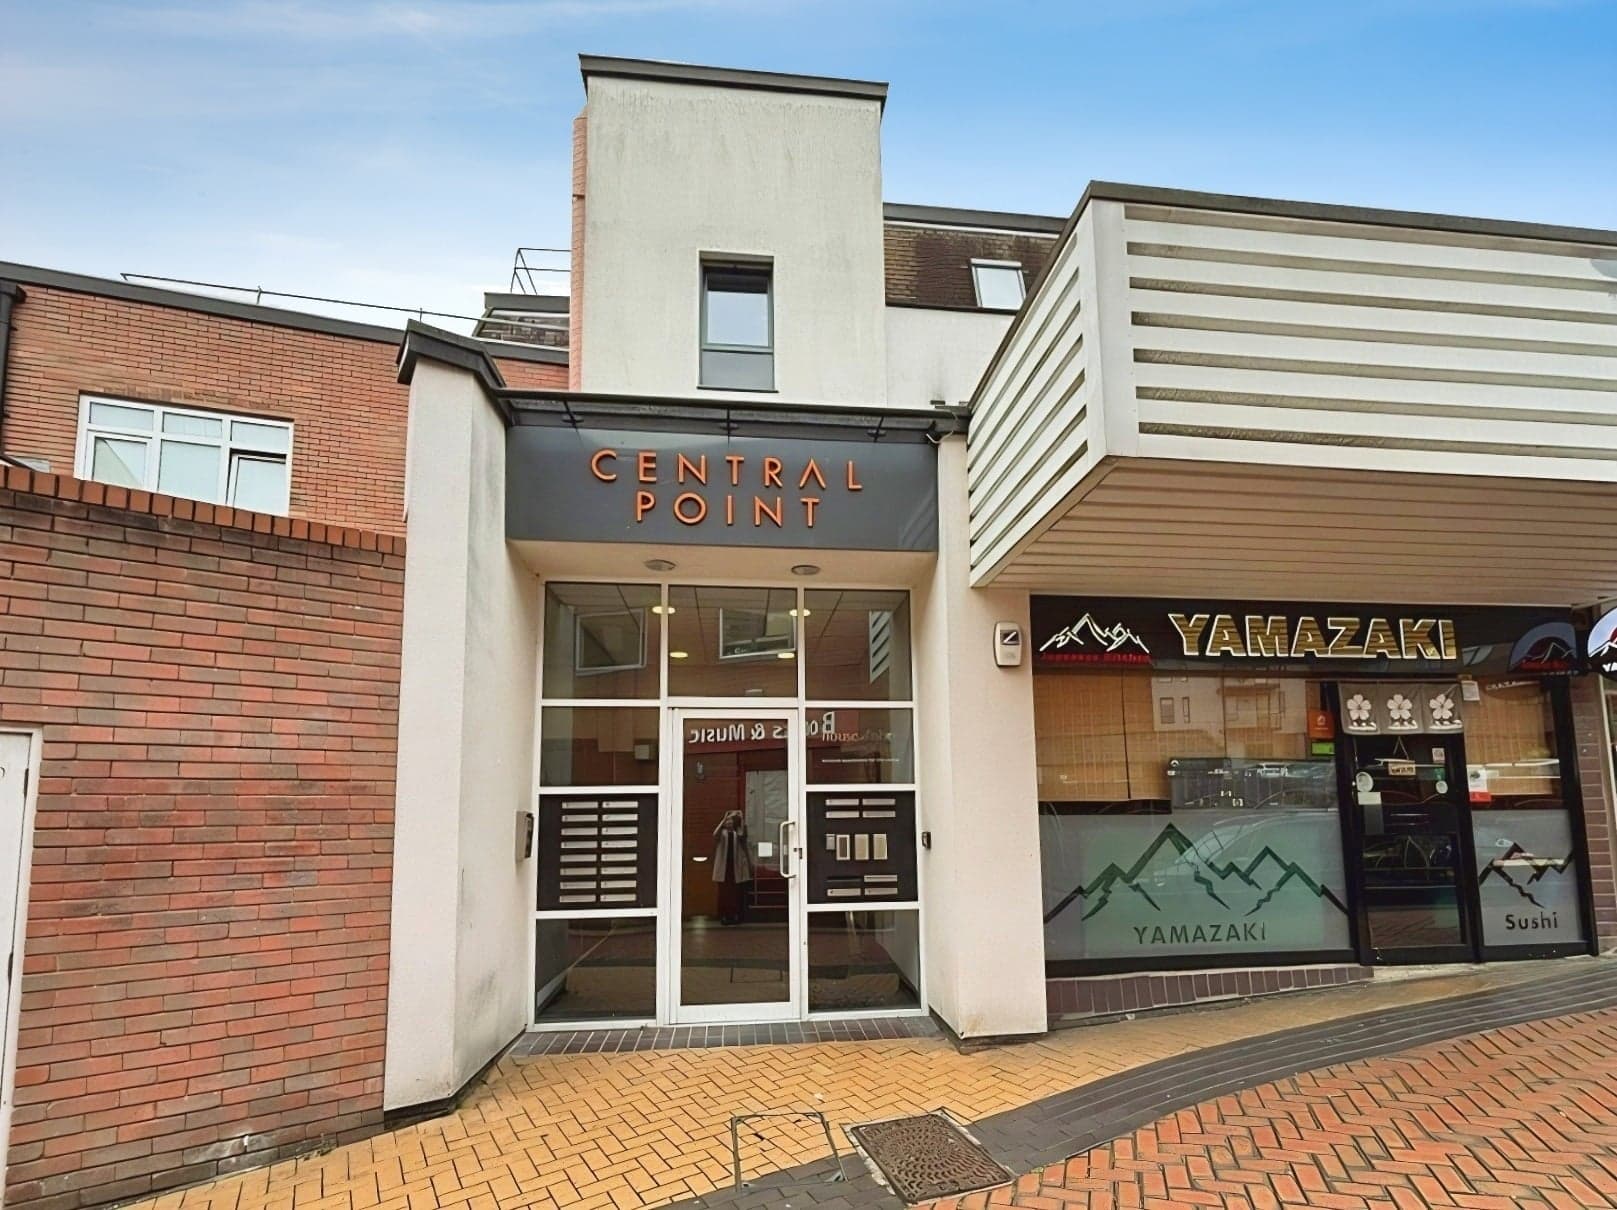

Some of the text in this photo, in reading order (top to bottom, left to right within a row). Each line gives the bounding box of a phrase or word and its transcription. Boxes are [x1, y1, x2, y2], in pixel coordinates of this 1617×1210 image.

[590, 448, 863, 490] CENTRAL
[636, 490, 820, 528] POINT
[1167, 613, 1457, 660] YAMAZAKI
[1133, 921, 1266, 945] YAMAZAKI
[1505, 911, 1558, 930] Sushi
